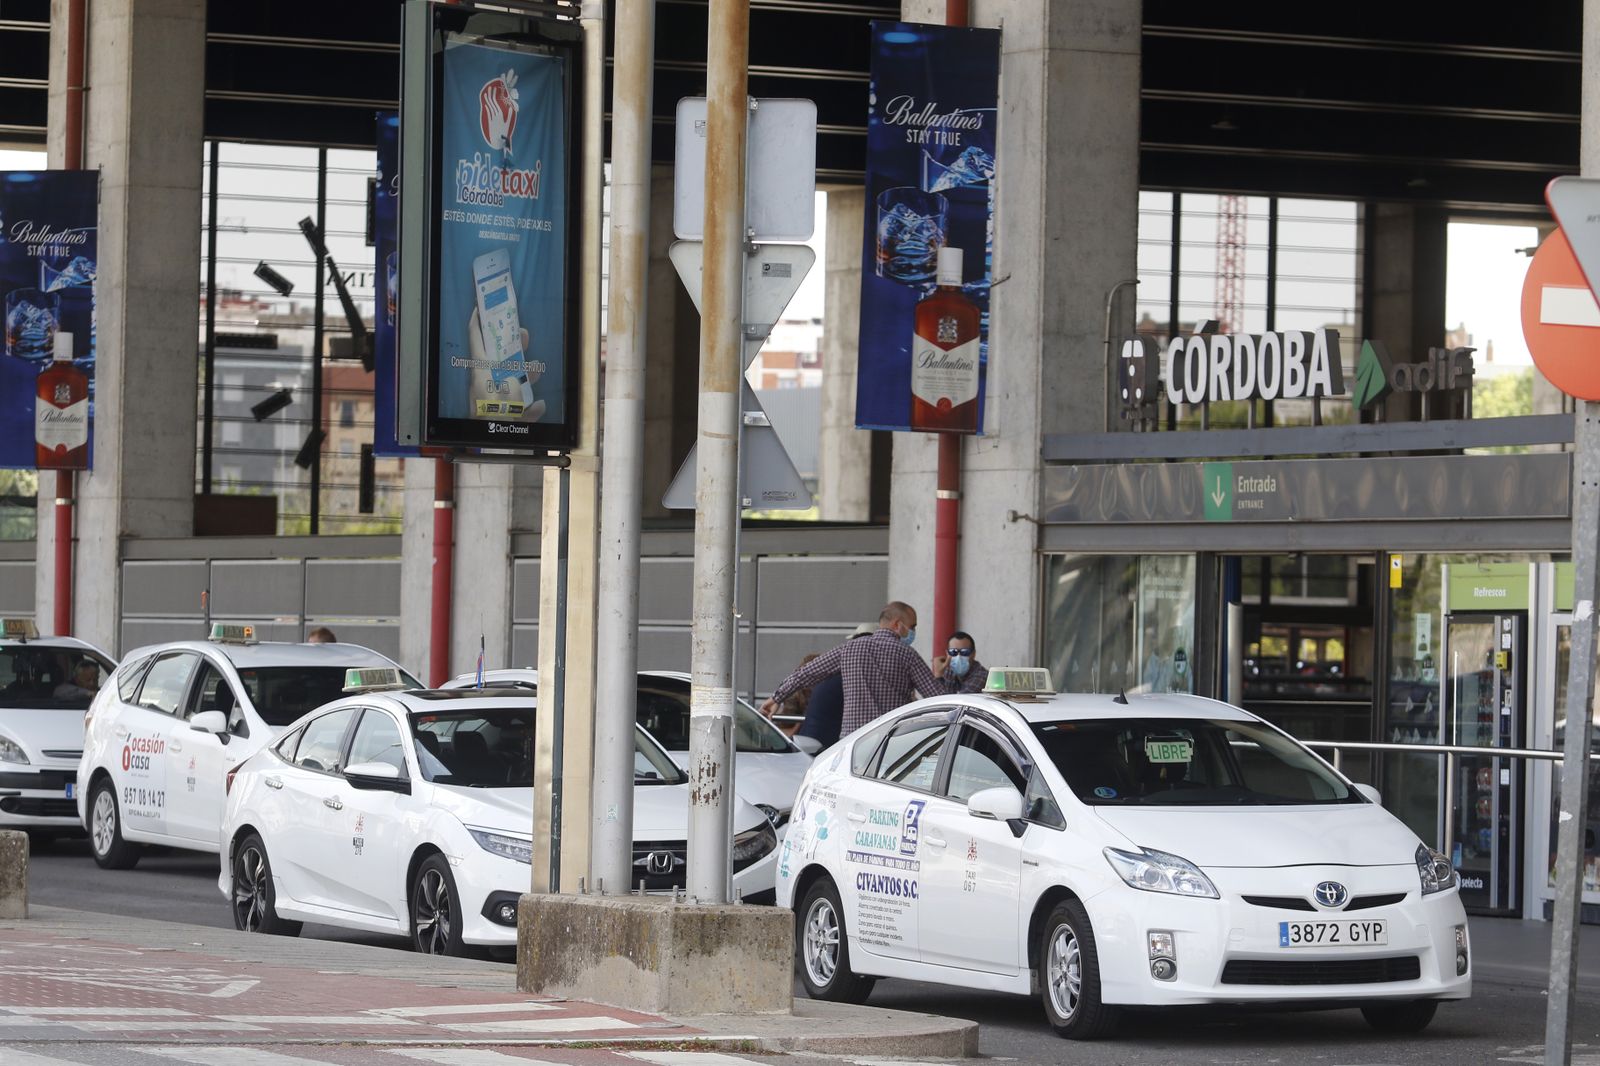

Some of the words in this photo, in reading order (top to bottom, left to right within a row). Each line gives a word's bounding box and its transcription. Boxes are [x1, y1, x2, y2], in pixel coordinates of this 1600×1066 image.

[883, 95, 983, 130] Ballantine's
[907, 129, 930, 143] STAY
[935, 131, 961, 146] TRUE
[462, 186, 504, 206] Córdoba
[466, 213, 493, 225] DONDE
[8, 220, 88, 245] Ballantine's
[27, 244, 46, 256] STAY
[49, 246, 70, 257] TRUE
[521, 361, 545, 373] SERVICIO
[917, 350, 974, 371] Ballantine's
[1166, 320, 1336, 404] CÓRDOBA
[1390, 347, 1474, 392] adif
[496, 424, 509, 432] Clear
[509, 425, 528, 434] Channel
[1238, 475, 1276, 493] Entrada
[1238, 500, 1264, 509] ENTRANCE
[1474, 587, 1507, 597] Refrescos
[1007, 672, 1033, 690] TAXI
[131, 732, 165, 754] ocasión
[1151, 744, 1188, 760] LIBRE
[131, 755, 150, 770] casa
[124, 787, 136, 804] 957
[148, 789, 156, 806] 14
[869, 809, 899, 827] PARKING
[855, 831, 897, 851] CARAVANAS
[857, 872, 901, 896] CIVANTOS
[903, 879, 919, 899] S.C.
[963, 880, 976, 892] 067
[1461, 877, 1483, 889] selecta
[1291, 923, 1340, 943] 3872
[1349, 922, 1383, 942] GYP
